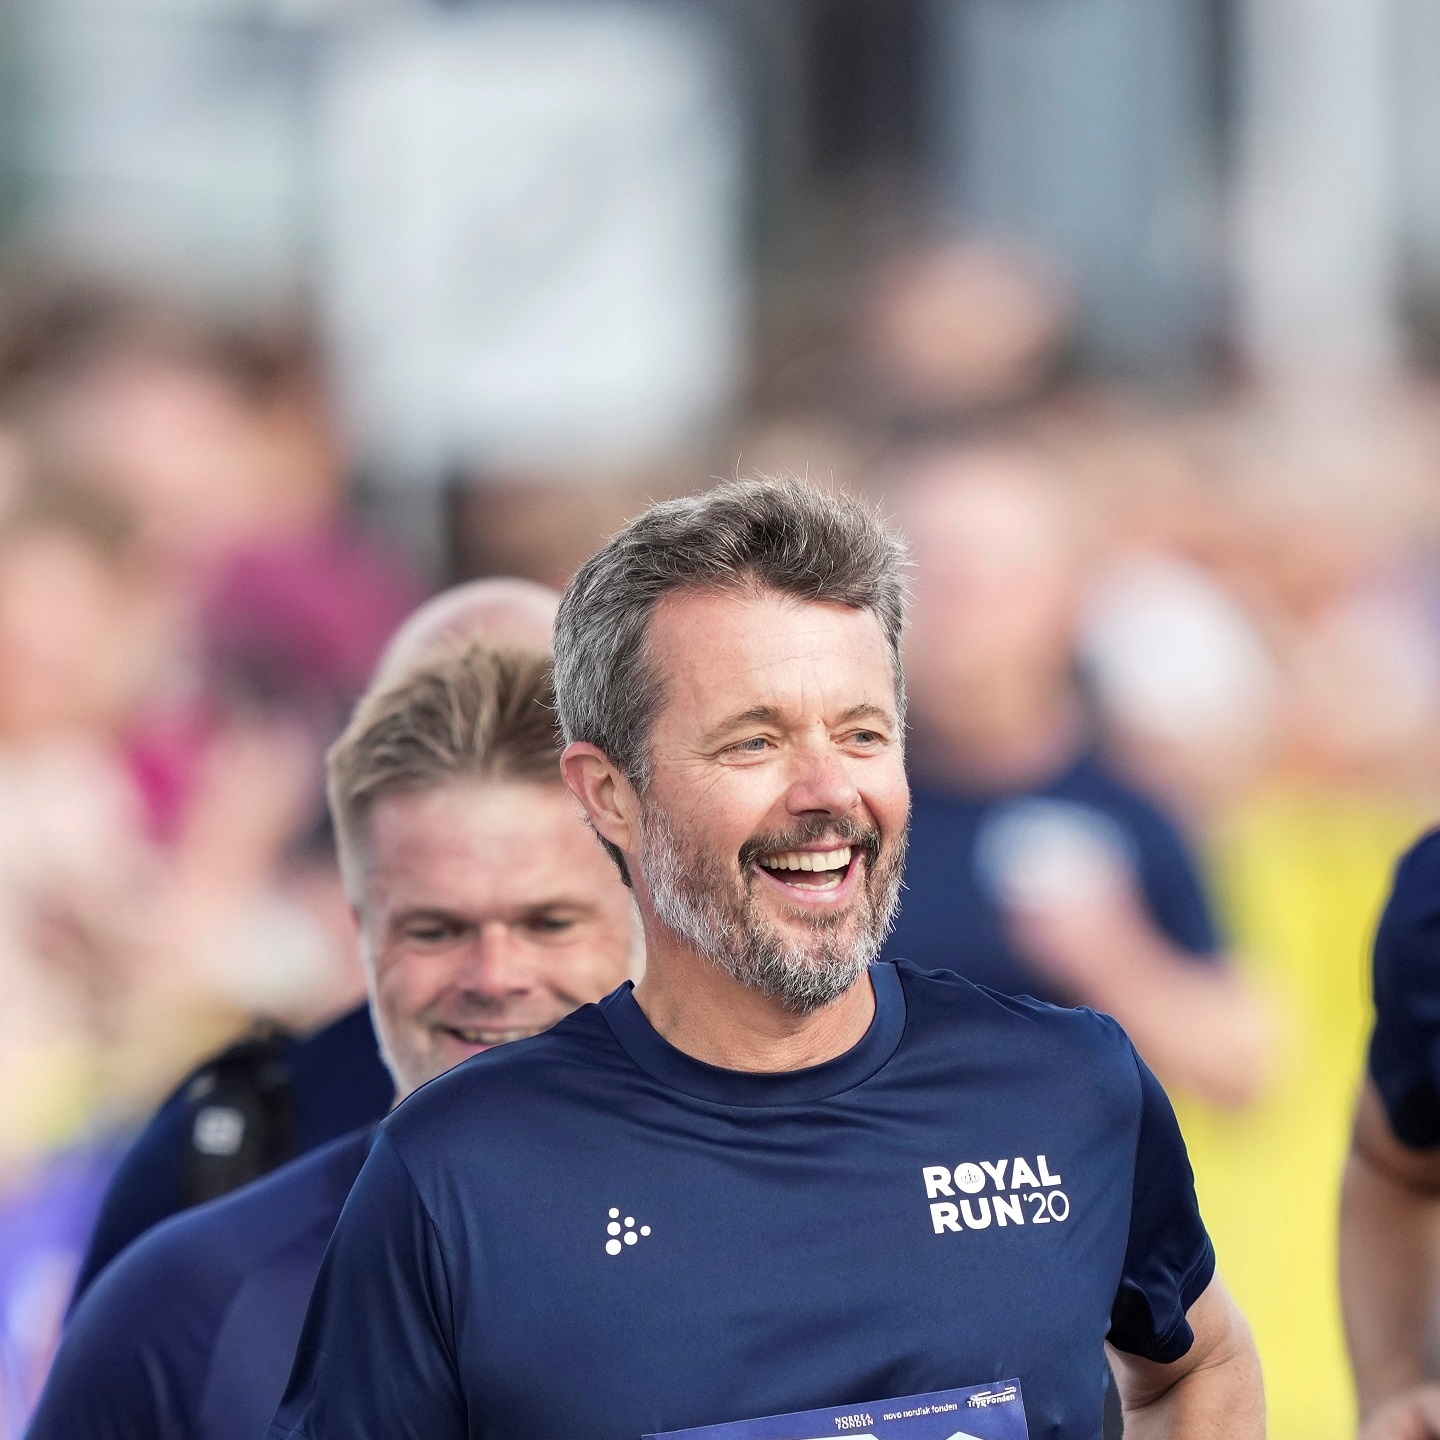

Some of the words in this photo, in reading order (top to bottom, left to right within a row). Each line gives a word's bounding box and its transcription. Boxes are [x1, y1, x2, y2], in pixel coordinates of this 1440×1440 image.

[922, 1155, 1062, 1199] ROYAL
[835, 1413, 871, 1425] NORDEA
[883, 1411, 902, 1421] novo
[903, 1406, 931, 1418] nordisk
[932, 1402, 958, 1414] fonden
[838, 1418, 874, 1430] FONDEN
